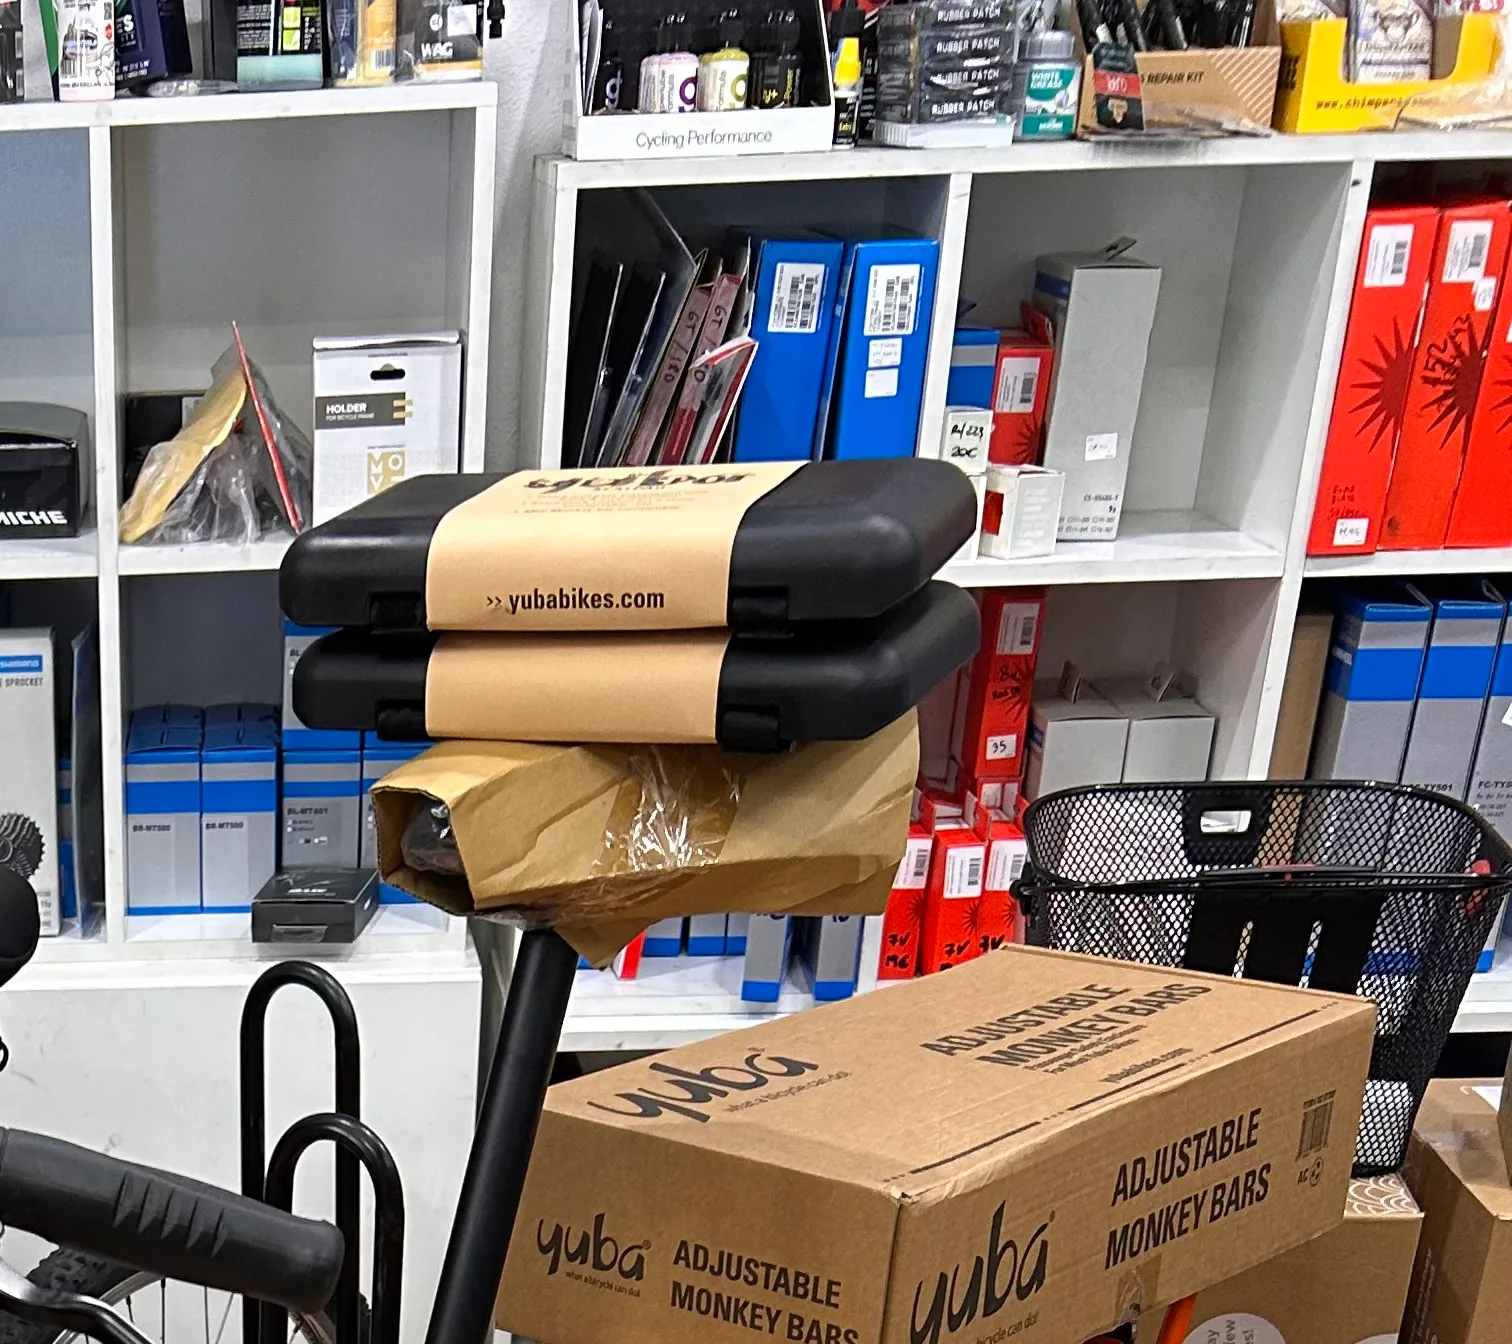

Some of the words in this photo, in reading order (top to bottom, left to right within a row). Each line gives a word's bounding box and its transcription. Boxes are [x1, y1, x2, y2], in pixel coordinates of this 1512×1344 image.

[421, 43, 454, 59] WAG
[1147, 71, 1185, 85] REPAIR
[1187, 71, 1205, 83] KIT
[636, 131, 684, 149] Cycling
[688, 128, 773, 146] Performance
[326, 403, 367, 414] HOLDER
[508, 587, 665, 615] yubabikes.com
[5, 677, 44, 687] SPROCKET
[920, 983, 1131, 1057] ADJUSTABLE
[975, 1013, 1132, 1067] MONKEY
[1106, 983, 1212, 1018] BARS
[587, 1053, 820, 1124] yuba
[1111, 1107, 1262, 1207] ADJUSTABLE
[1105, 1189, 1209, 1271] MONKEY
[1208, 1162, 1272, 1224] BARS
[536, 1212, 646, 1282] yuba
[565, 1270, 584, 1284] what
[673, 1239, 842, 1309] ADJUSTABLE
[670, 1279, 782, 1336] MONKEY
[1006, 1321, 1023, 1338] can
